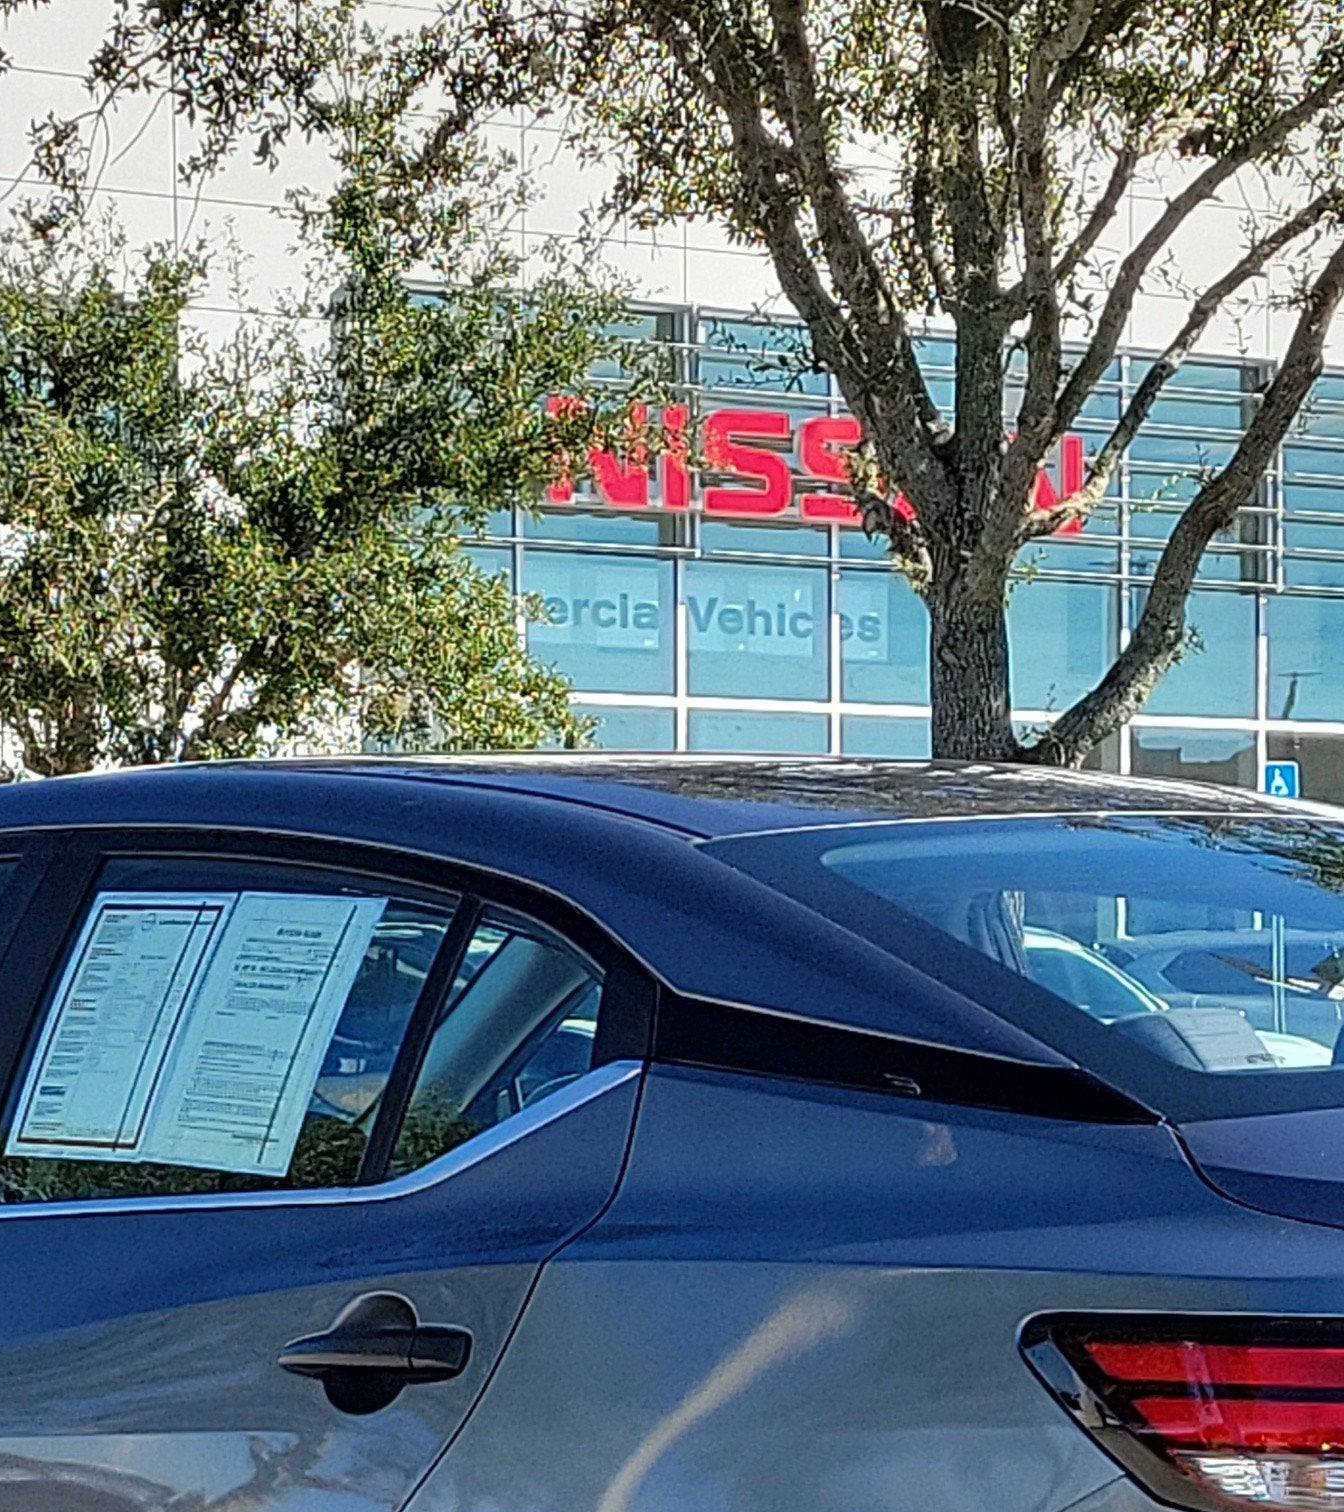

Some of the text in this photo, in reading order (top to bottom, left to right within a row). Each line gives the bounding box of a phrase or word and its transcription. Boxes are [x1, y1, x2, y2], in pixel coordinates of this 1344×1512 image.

[546, 395, 1084, 535] NISSN
[544, 592, 882, 643] ercia Vehices
